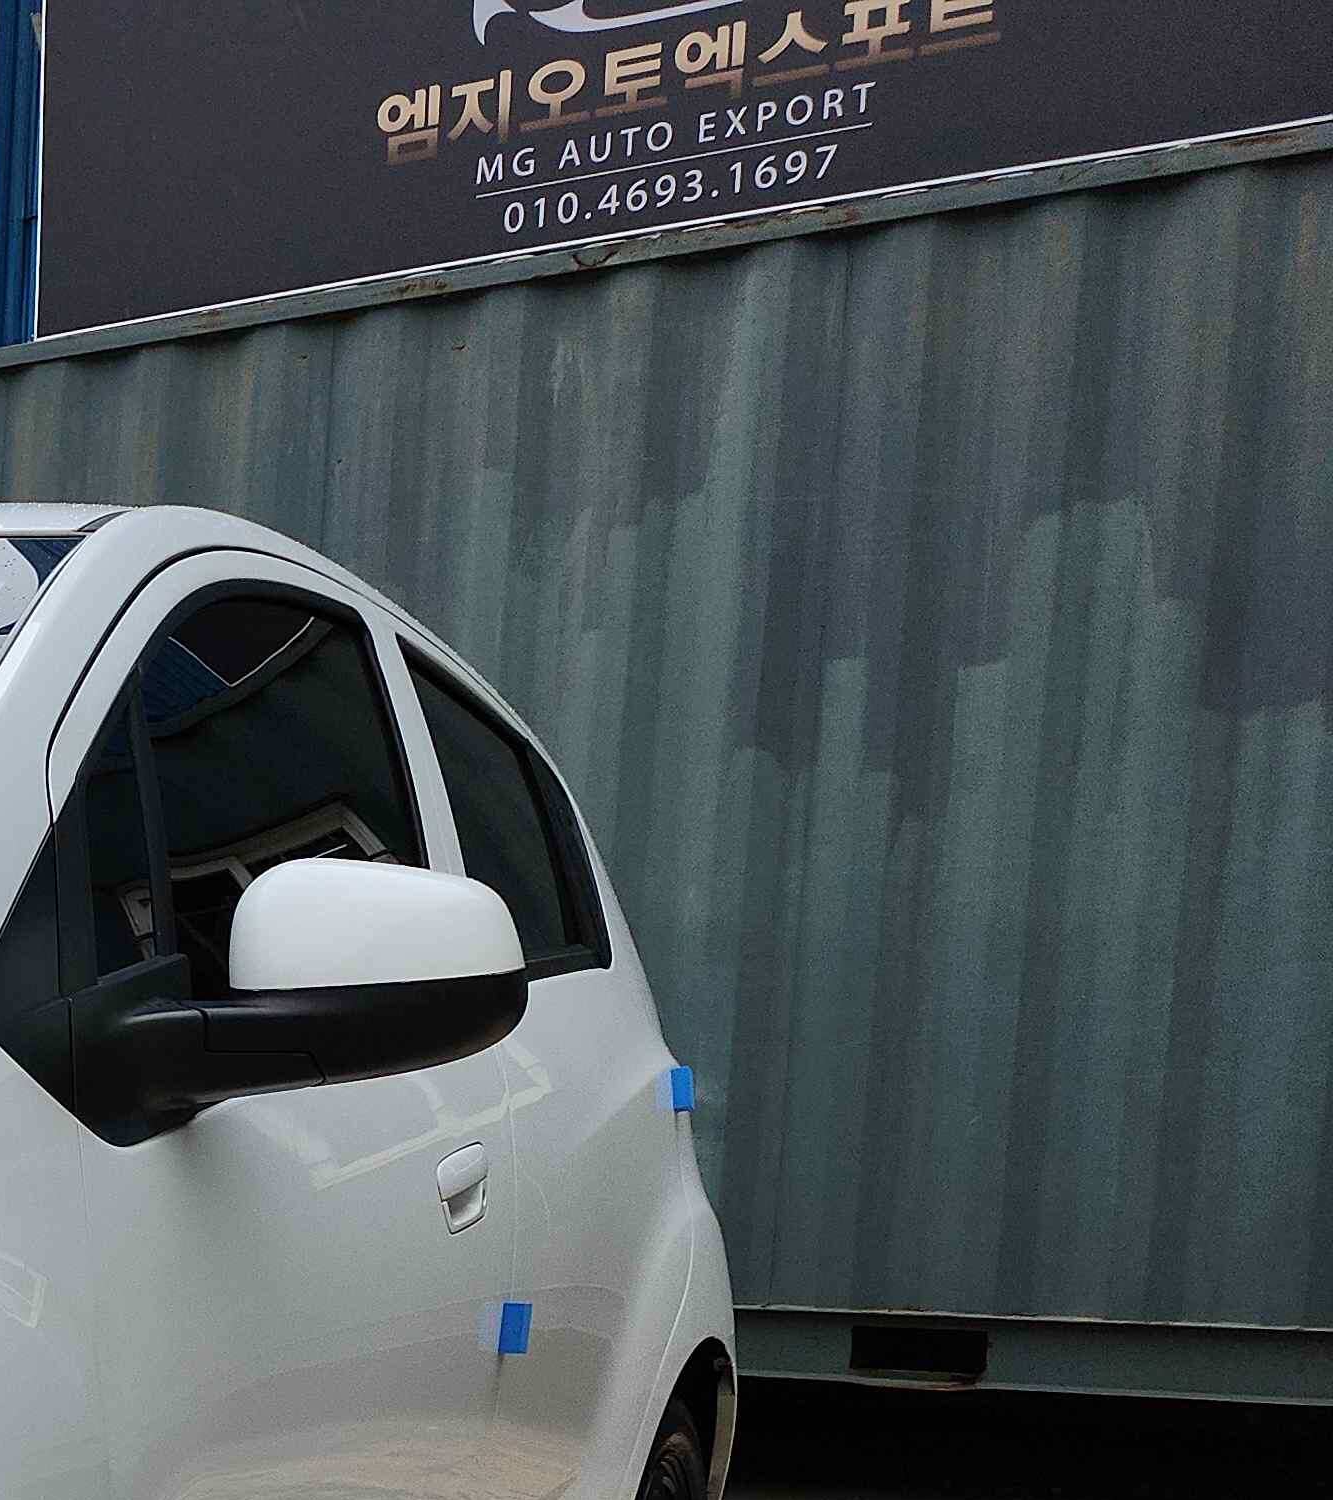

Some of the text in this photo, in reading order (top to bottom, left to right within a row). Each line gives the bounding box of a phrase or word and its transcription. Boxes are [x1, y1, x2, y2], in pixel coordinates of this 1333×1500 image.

[474, 81, 878, 186] MG AUTO EXPORT
[502, 144, 840, 235] 010.4693.1697
